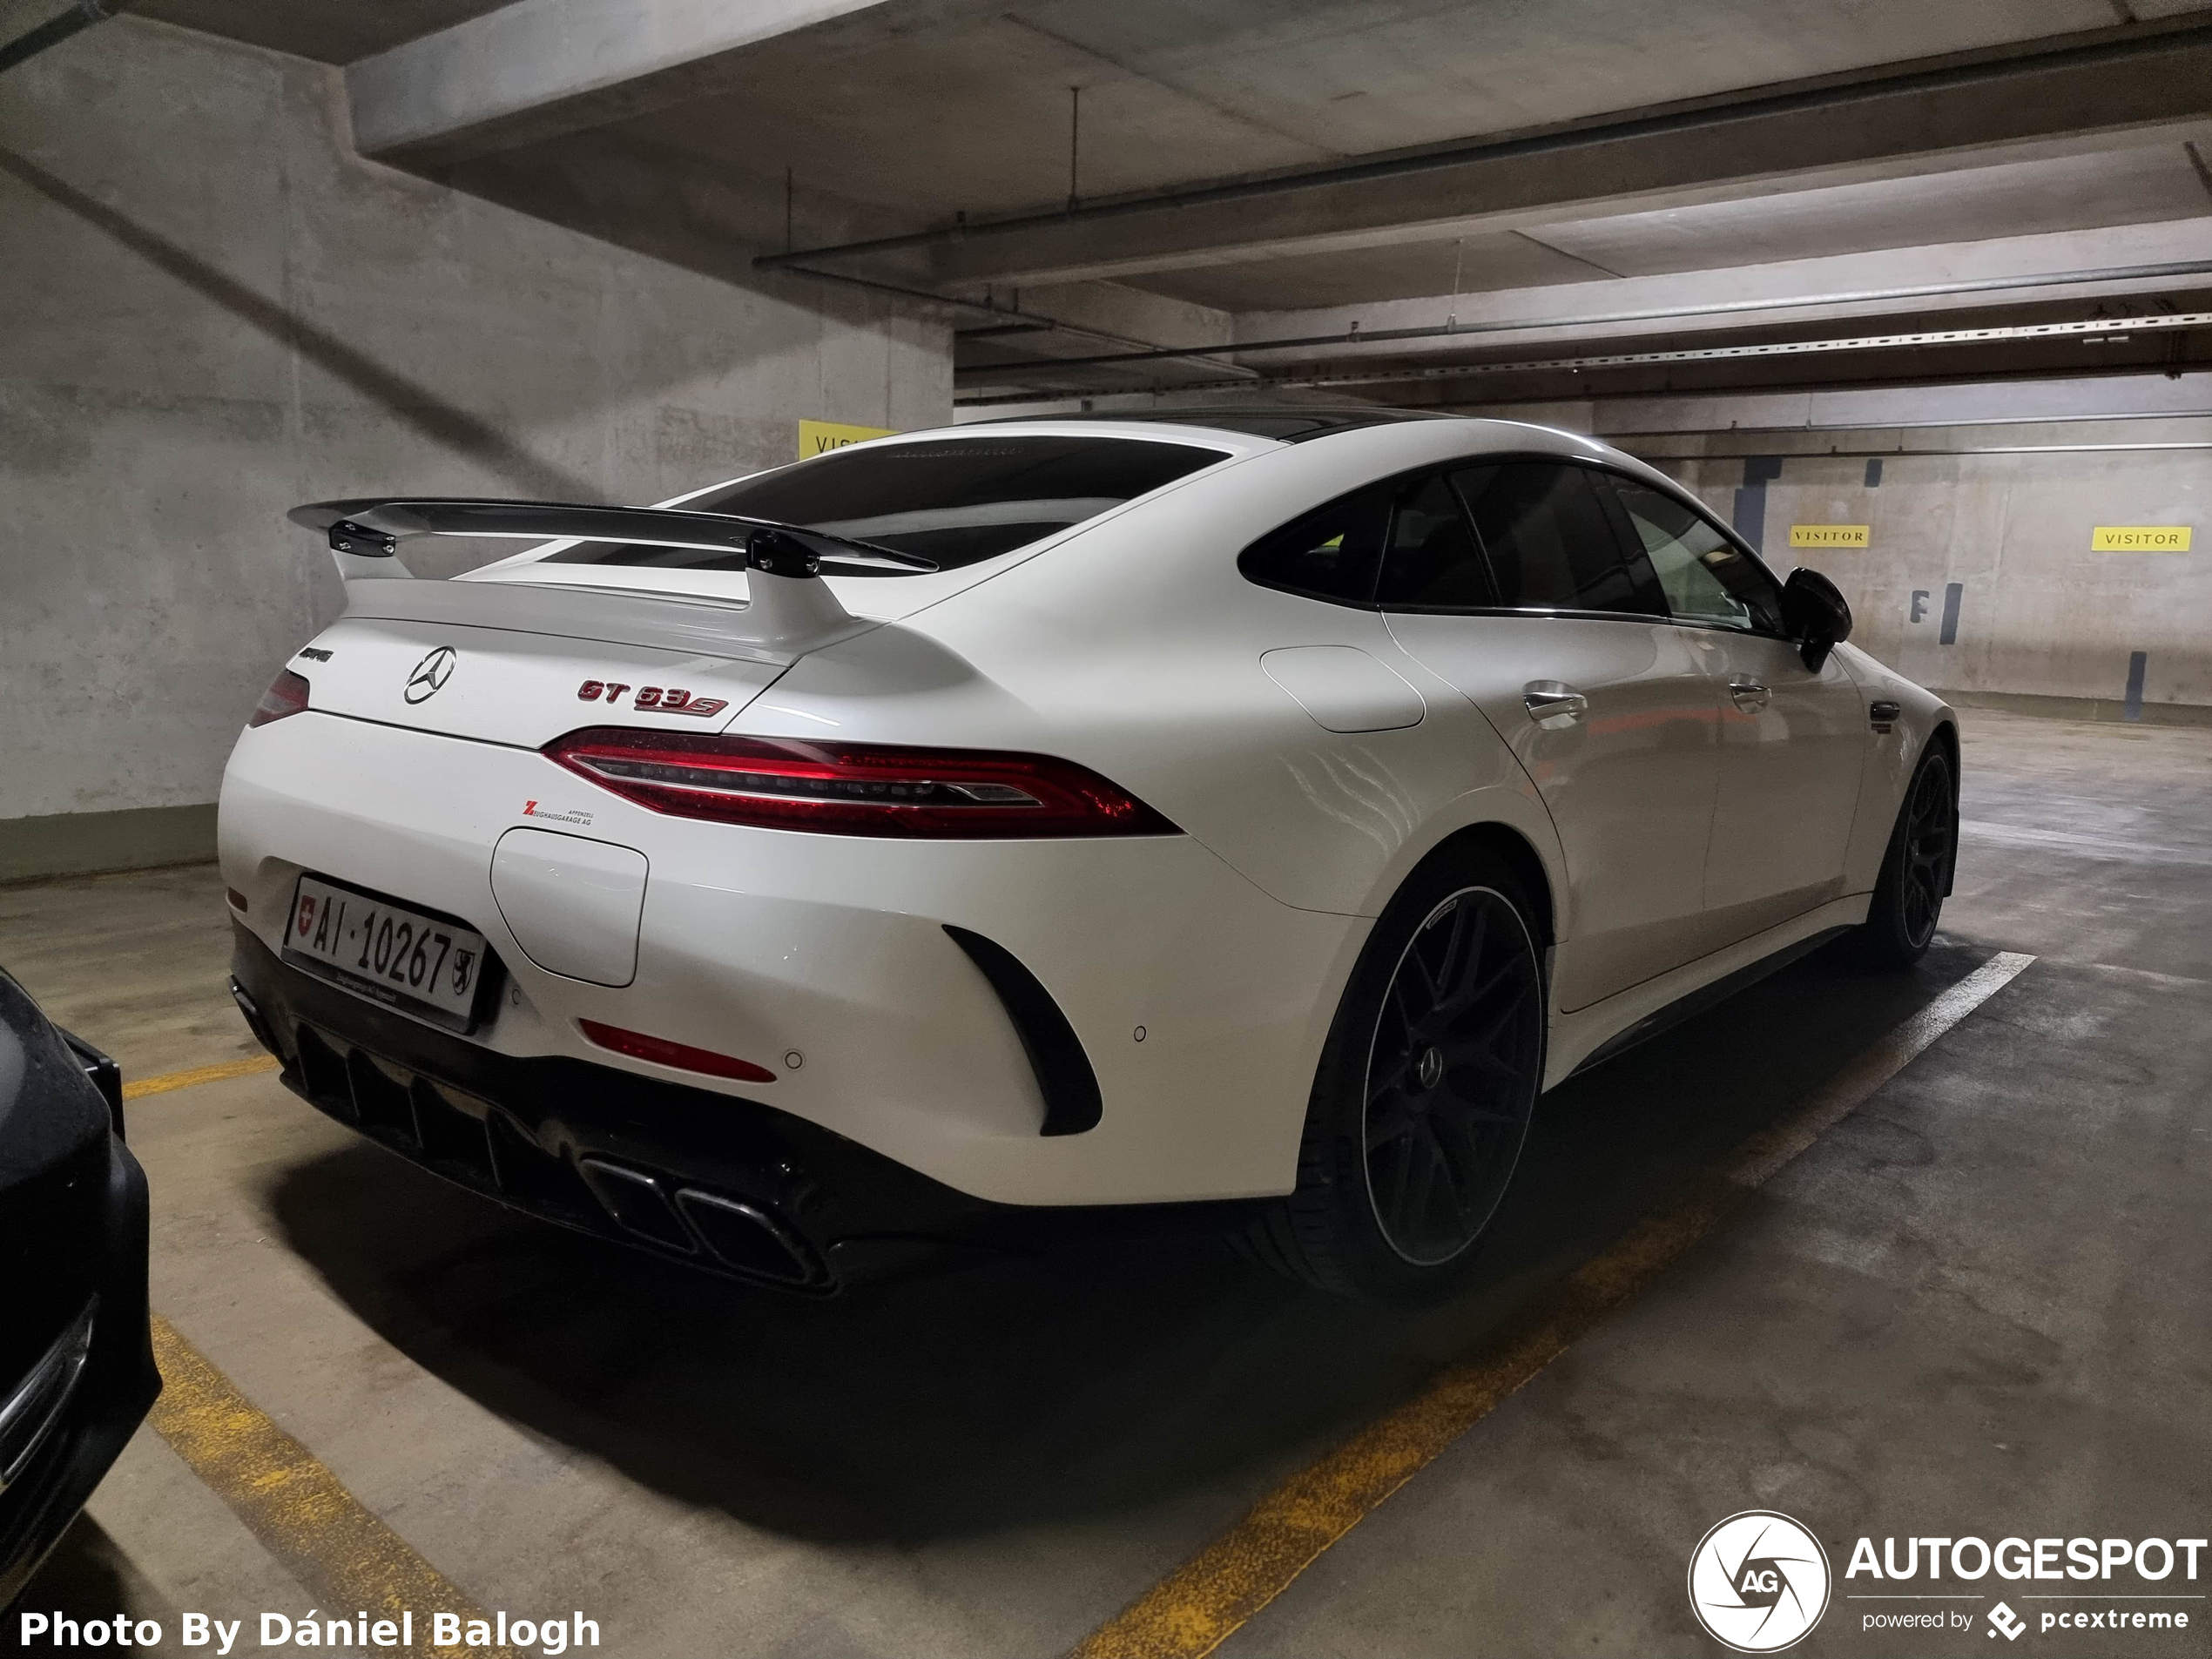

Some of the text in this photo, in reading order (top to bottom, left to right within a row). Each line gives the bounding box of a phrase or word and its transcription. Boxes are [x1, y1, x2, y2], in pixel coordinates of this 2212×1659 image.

[1795, 530, 1864, 542] VISITOR
[2105, 533, 2180, 545] VISITOR
[577, 679, 631, 705] GT
